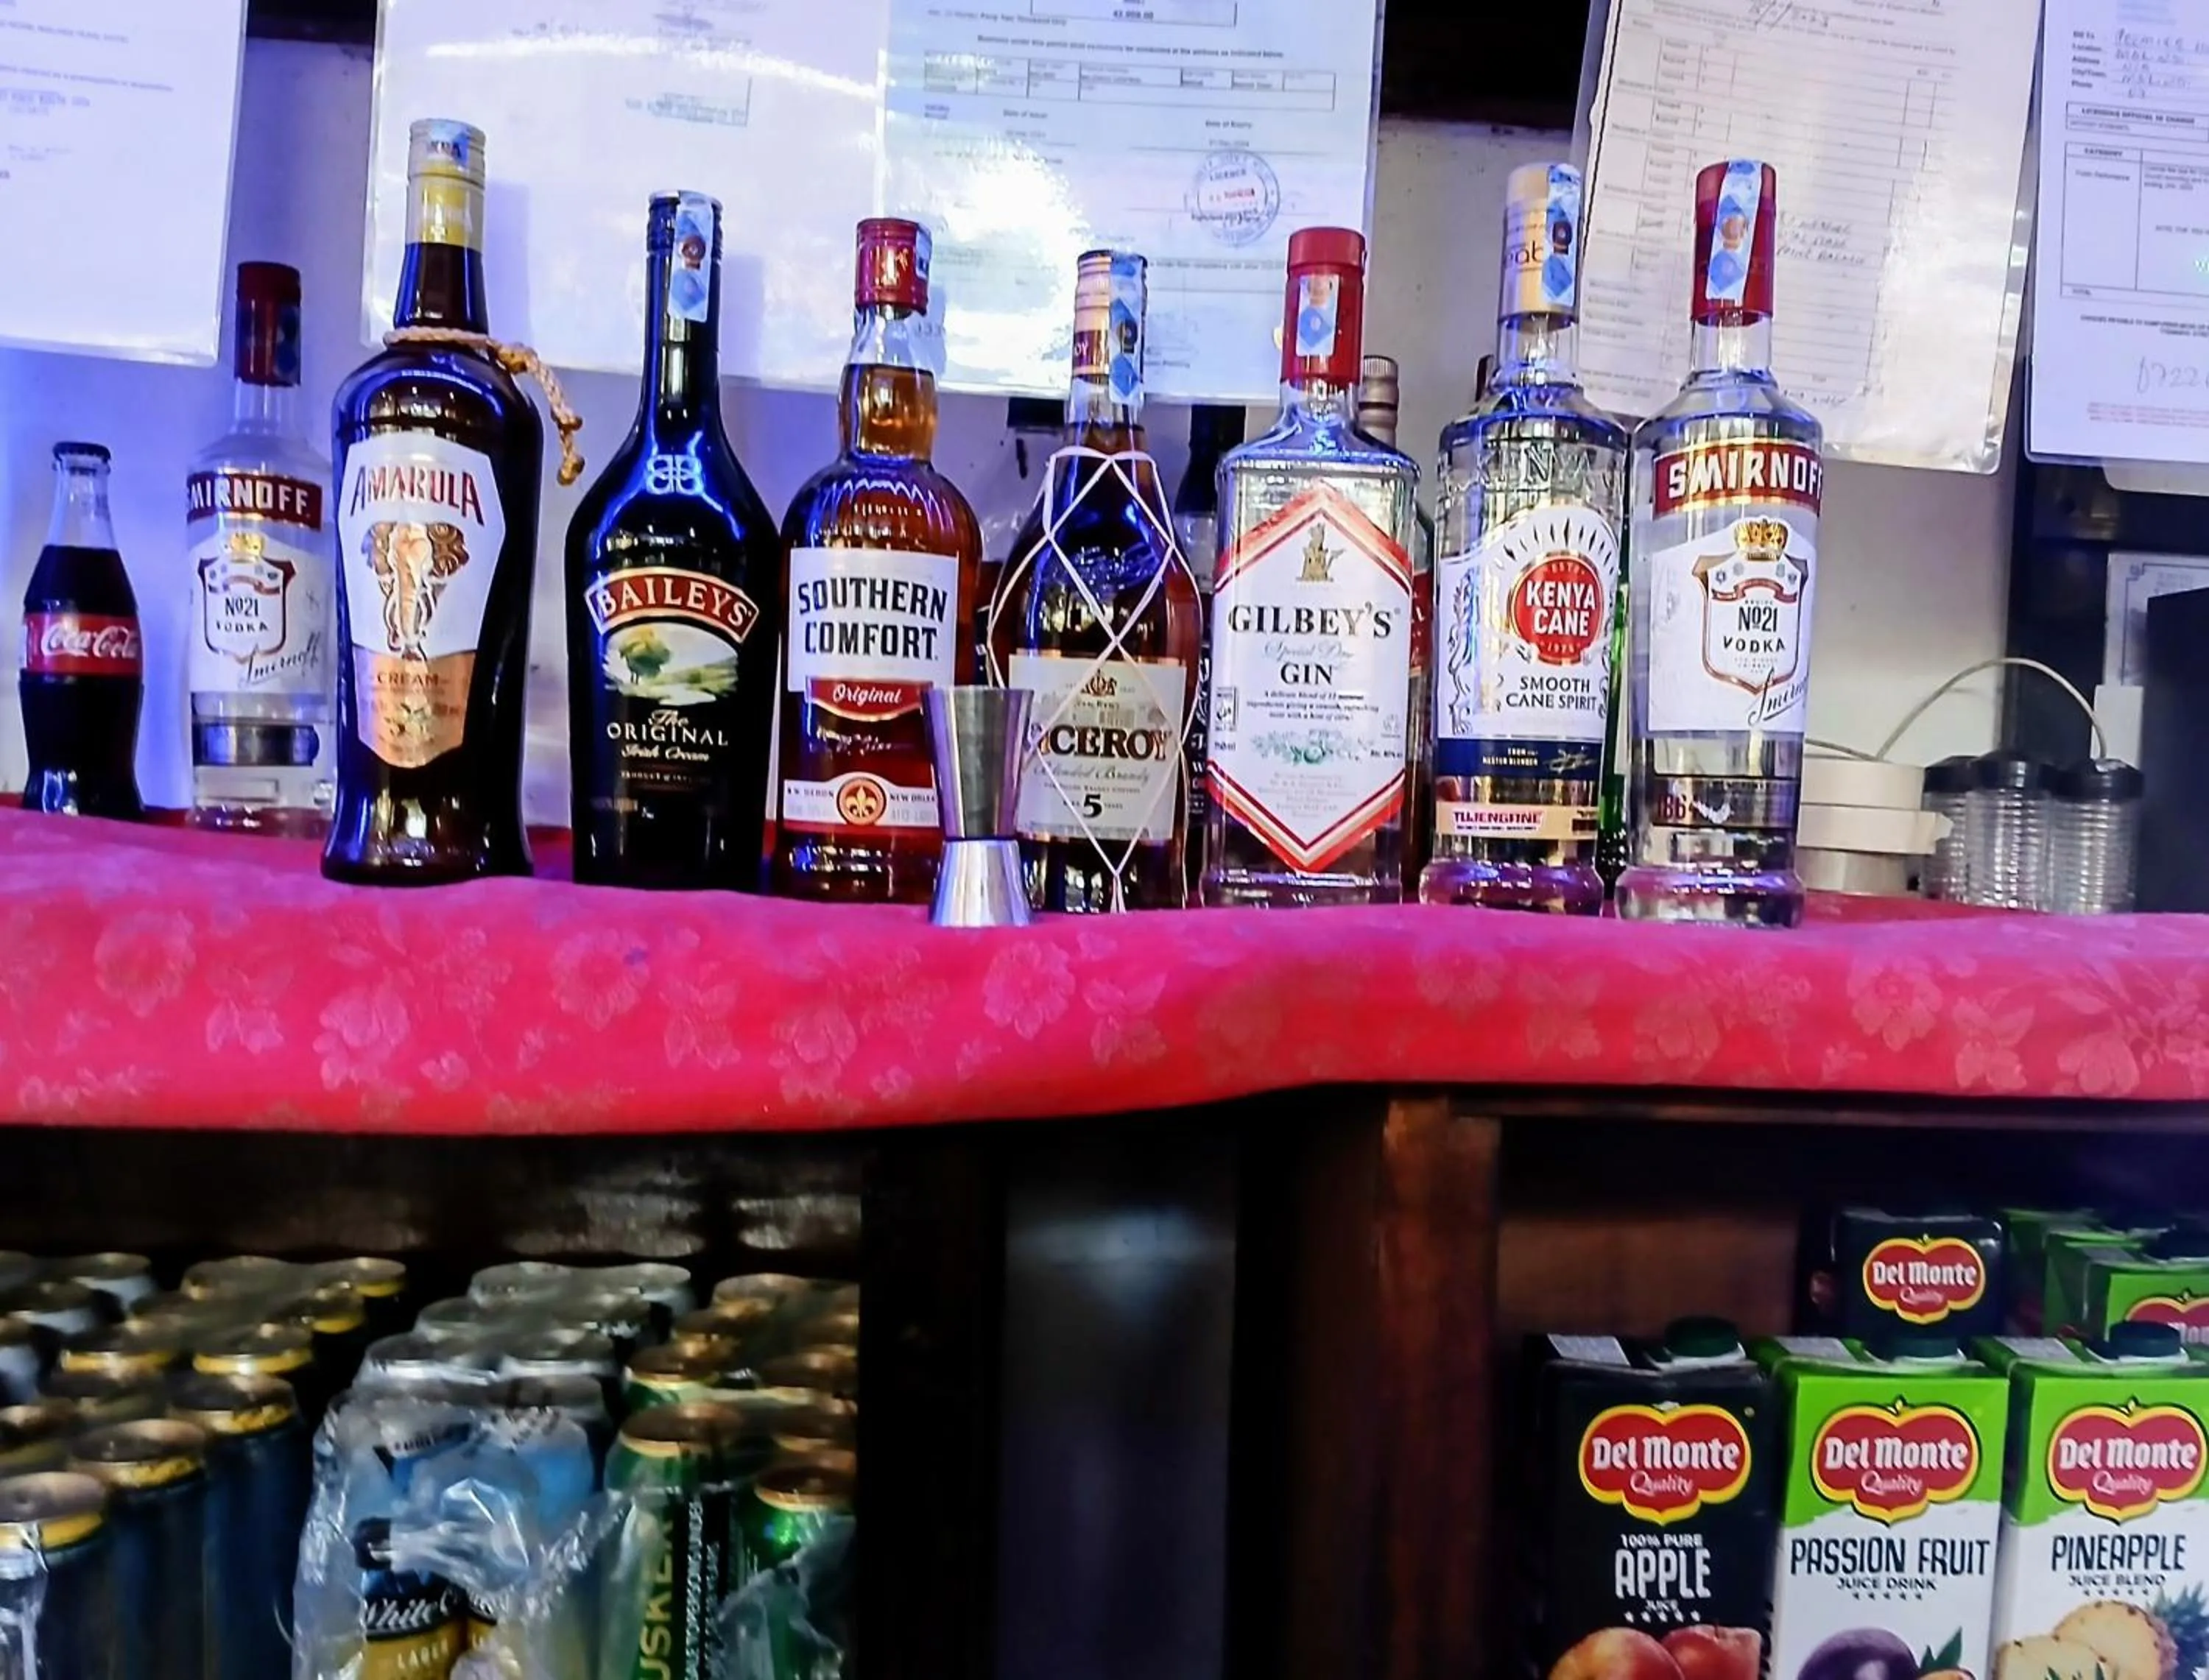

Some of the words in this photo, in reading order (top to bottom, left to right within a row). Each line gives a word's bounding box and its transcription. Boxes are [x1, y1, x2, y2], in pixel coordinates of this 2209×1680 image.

[350, 465, 485, 526] AMARULA
[596, 578, 749, 627] BAILEYS
[797, 577, 948, 623] SOUTHERN
[1526, 580, 1596, 610] KENYA
[1228, 601, 1392, 638] GILBEY'S
[1533, 609, 1590, 637] CANE
[805, 621, 938, 660] COMFORT
[1723, 635, 1786, 653] VODKA
[377, 671, 439, 685] CREAM
[1280, 663, 1333, 685] GIN
[1519, 676, 1590, 693] SMOOTH
[833, 683, 902, 707] Original
[1506, 693, 1554, 708] CANE
[1558, 694, 1597, 711] SPIRIT
[648, 709, 689, 727] The
[607, 722, 728, 746] ORIGINAL
[665, 746, 710, 762] Cream
[1082, 794, 1103, 818] 5
[1872, 1261, 1905, 1285] Del
[1909, 1261, 1977, 1287] Monte
[1592, 1436, 1638, 1469] Del
[1643, 1436, 1740, 1471] Monte
[1825, 1437, 1870, 1469] Del
[1874, 1437, 1968, 1470] Monte
[2060, 1438, 2102, 1469] Del
[2107, 1438, 2198, 1470] Monte
[1630, 1471, 1693, 1497] Quality
[1861, 1471, 1923, 1497] Quality
[2093, 1471, 2153, 1496] Quality
[1621, 1533, 1660, 1547] 100%
[1663, 1533, 1703, 1547] PURE
[2051, 1535, 2187, 1571] PINEAPPLE
[1790, 1536, 1906, 1575] PASSION
[1918, 1538, 1991, 1576] FRUIT
[1615, 1549, 1711, 1599] APPLE
[1837, 1578, 1880, 1590] JUICE
[1886, 1578, 1937, 1591] DRINK
[2069, 1574, 2110, 1587] JUICE
[2115, 1574, 2166, 1587] BLEND
